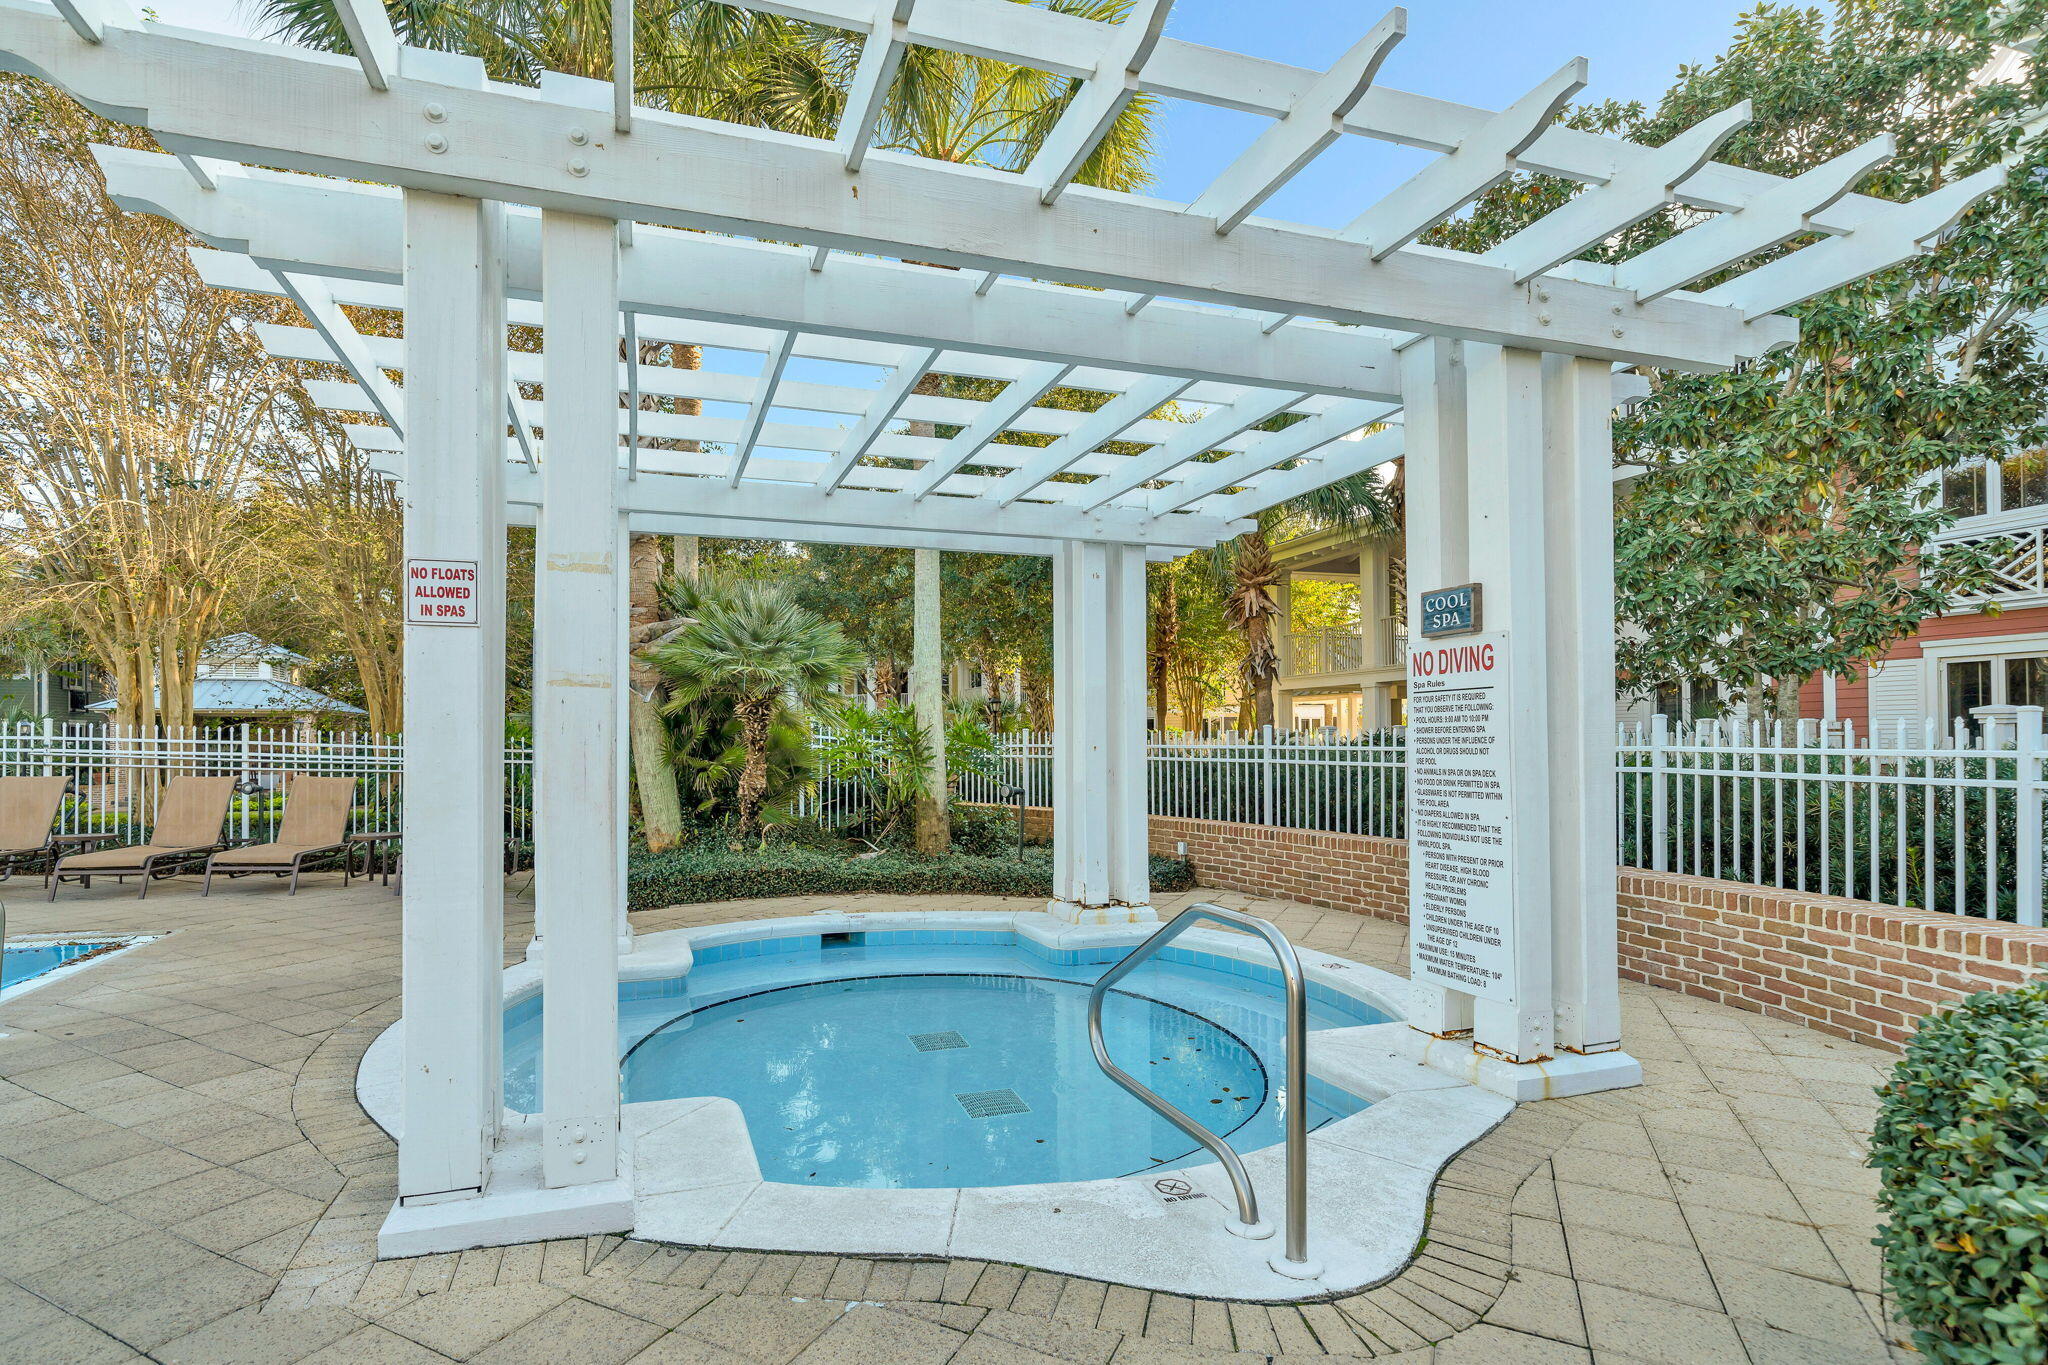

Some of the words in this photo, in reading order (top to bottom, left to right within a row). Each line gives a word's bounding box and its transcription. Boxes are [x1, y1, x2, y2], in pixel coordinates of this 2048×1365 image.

[410, 567, 428, 579] NO
[431, 567, 475, 581] FLOATS
[415, 585, 470, 599] ALLOWED
[1426, 592, 1468, 613] COOL
[420, 604, 432, 616] IN
[436, 604, 466, 617] SPAS
[1432, 612, 1461, 629] SPA
[1413, 650, 1433, 677] NO
[1438, 643, 1494, 675] DIVING
[1413, 680, 1426, 689] Spa
[1427, 680, 1445, 688] Rules
[1422, 695, 1434, 703] YOUR
[1434, 694, 1451, 702] SAFETY
[1451, 693, 1456, 701] IT
[1456, 693, 1461, 701] IS
[1462, 692, 1486, 700] REQUIRED
[1413, 706, 1424, 714] THAT
[1424, 705, 1433, 713] YOU
[1434, 704, 1454, 713] OBSERVE
[1455, 704, 1463, 712] THE
[1416, 716, 1428, 724] POOL
[1416, 726, 1434, 734] SHOWER
[1434, 726, 1452, 734] BEFORE
[1452, 725, 1475, 733] ENTERING
[1476, 725, 1486, 733] SPA
[1461, 736, 1487, 744] INFLUENCE
[1488, 736, 1495, 744] OF
[1416, 747, 1436, 755] ALCOHOL
[1436, 747, 1443, 755] OR
[1443, 747, 1459, 755] DRUGS
[1459, 747, 1478, 755] SHOULD
[1479, 747, 1490, 755] NOT
[1416, 757, 1425, 765] USE
[1423, 768, 1442, 776] ANIMALS
[1447, 768, 1456, 776] SPA
[1464, 769, 1471, 777] ON
[1472, 769, 1481, 777] SPA
[1482, 769, 1496, 777] DECK
[1443, 779, 1456, 787] DRINK
[1457, 780, 1483, 788] PERMITTED
[1490, 781, 1500, 789] SPA
[1417, 788, 1442, 797] GLASSWARE
[1448, 790, 1458, 798] NOT
[1458, 790, 1484, 800] PERMITTED
[1485, 792, 1503, 800] WITHIN
[1437, 800, 1450, 808] AREA
[1424, 809, 1442, 818] DIAPERS
[1442, 811, 1464, 819] ALLOWED
[1465, 812, 1470, 820] IN
[1470, 813, 1480, 821] SPA
[1421, 819, 1426, 827] IS
[1426, 820, 1441, 828] HIGHLY
[1442, 821, 1477, 832] RECOMMENDED
[1478, 824, 1490, 833] THAT
[1491, 825, 1502, 834] THE
[1417, 829, 1441, 839] FOLLOWING
[1442, 832, 1470, 842] INDIVIDUALS
[1470, 835, 1480, 843] NOT
[1481, 836, 1491, 844] USE
[1492, 837, 1503, 846] THE
[1417, 839, 1441, 850] WHIRLPOOL
[1425, 850, 1445, 860] PERSONS
[1446, 853, 1457, 862] WITH
[1457, 855, 1479, 865] PRESENT
[1479, 858, 1487, 866] OR
[1488, 858, 1504, 868] PRIOR
[1425, 861, 1439, 870] HEART
[1460, 866, 1471, 875] HIGH
[1472, 868, 1490, 878] BLOOD
[1449, 875, 1457, 883] OR
[1457, 877, 1467, 885] ANY
[1467, 878, 1489, 888] CHRONIC
[1425, 882, 1441, 891] HEALTH
[1442, 885, 1467, 896] PROBLEMS
[1425, 892, 1448, 903] PREGNANT
[1449, 896, 1467, 907] WOMEN
[1425, 902, 1444, 913] ELDERLY
[1445, 906, 1467, 917] PERSONS
[1425, 913, 1447, 924] CHILDREN
[1448, 917, 1463, 928] UNDER
[1464, 921, 1473, 930] THE
[1474, 923, 1485, 932] AGE
[1485, 925, 1492, 933] OF
[1493, 927, 1499, 935] 10
[1425, 923, 1458, 938] UNSUPERVISED
[1459, 931, 1483, 943] CHILDREN
[1484, 936, 1502, 947] UNDER
[1427, 933, 1435, 943] THE
[1435, 936, 1445, 945] AGE
[1446, 938, 1452, 946] OF
[1418, 942, 1438, 953] MAXIMUM
[1455, 951, 1476, 963] MINUTES
[1418, 952, 1439, 963] MAXIMUM
[1439, 958, 1454, 968] WATER
[1426, 965, 1447, 976] MAXIMUM
[1447, 970, 1467, 983] BATHING
[1177, 1192, 1208, 1201] DIVING
